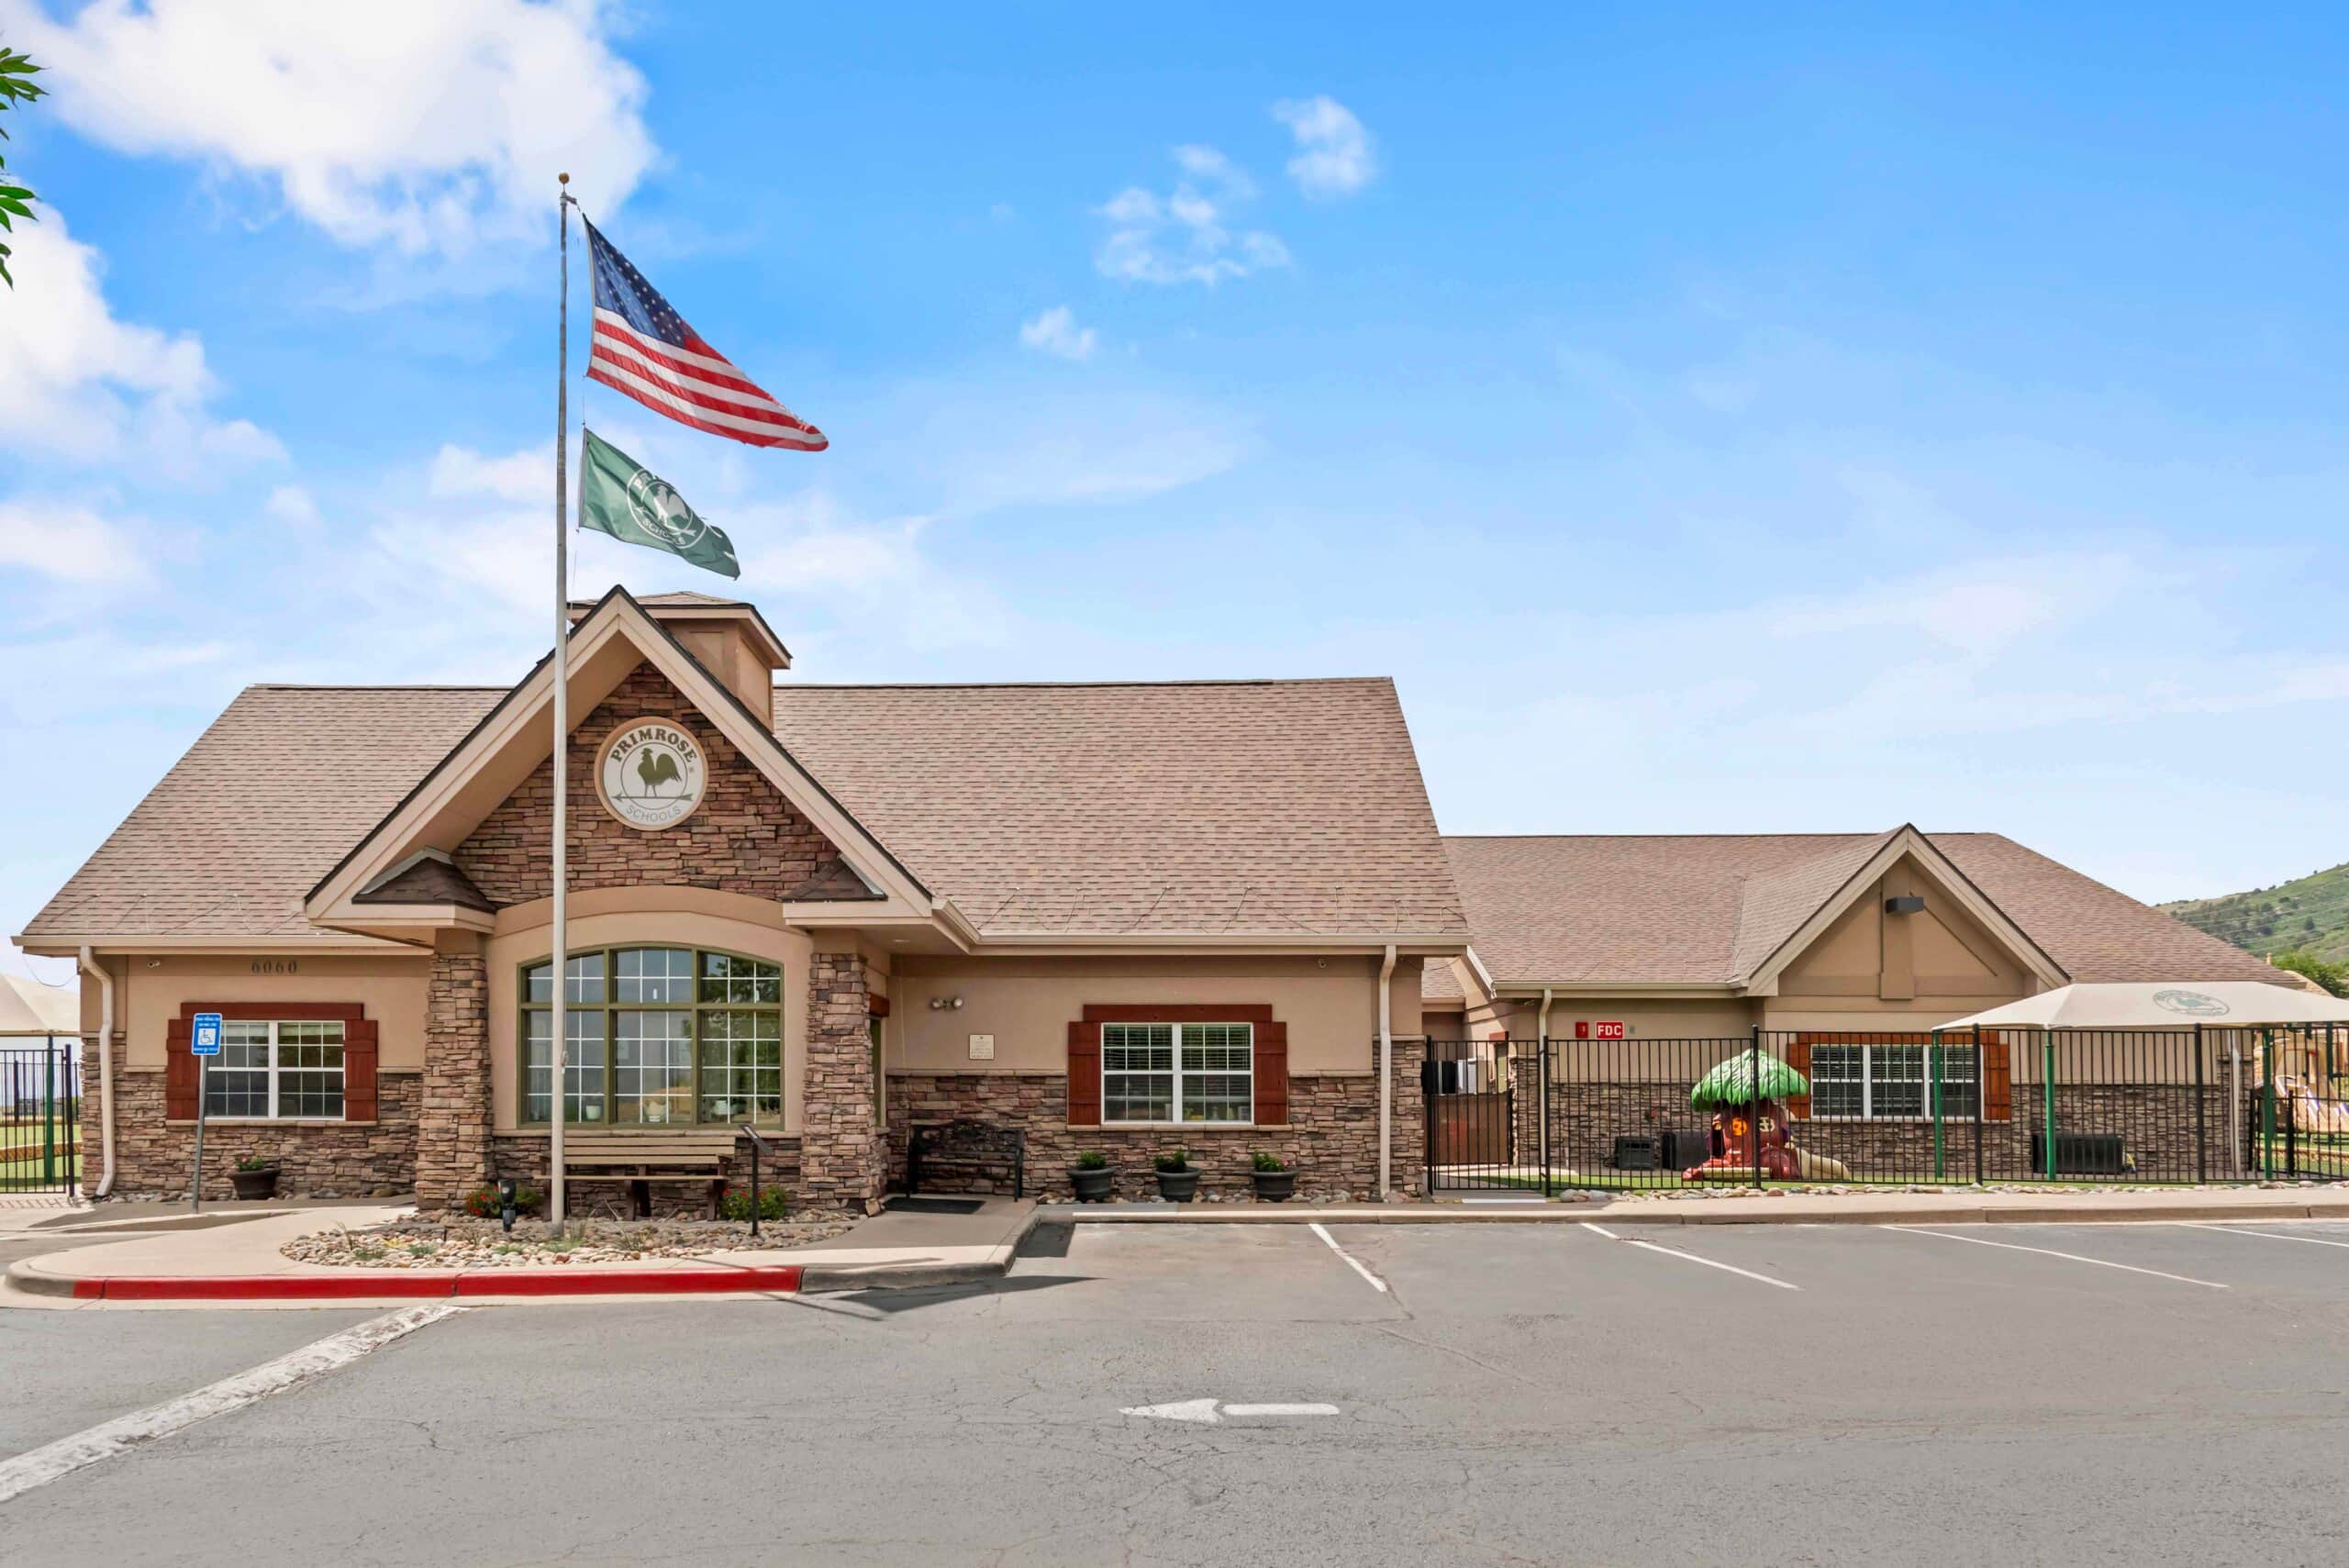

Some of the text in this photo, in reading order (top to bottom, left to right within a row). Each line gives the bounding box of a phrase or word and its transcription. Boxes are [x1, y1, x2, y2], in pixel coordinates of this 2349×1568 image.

[643, 517, 686, 545] SCHOLS
[610, 728, 697, 762] PRIMROSE
[626, 806, 681, 822] SCHOOLS
[251, 961, 297, 973] 6060
[1598, 1025, 1622, 1036] FDC
